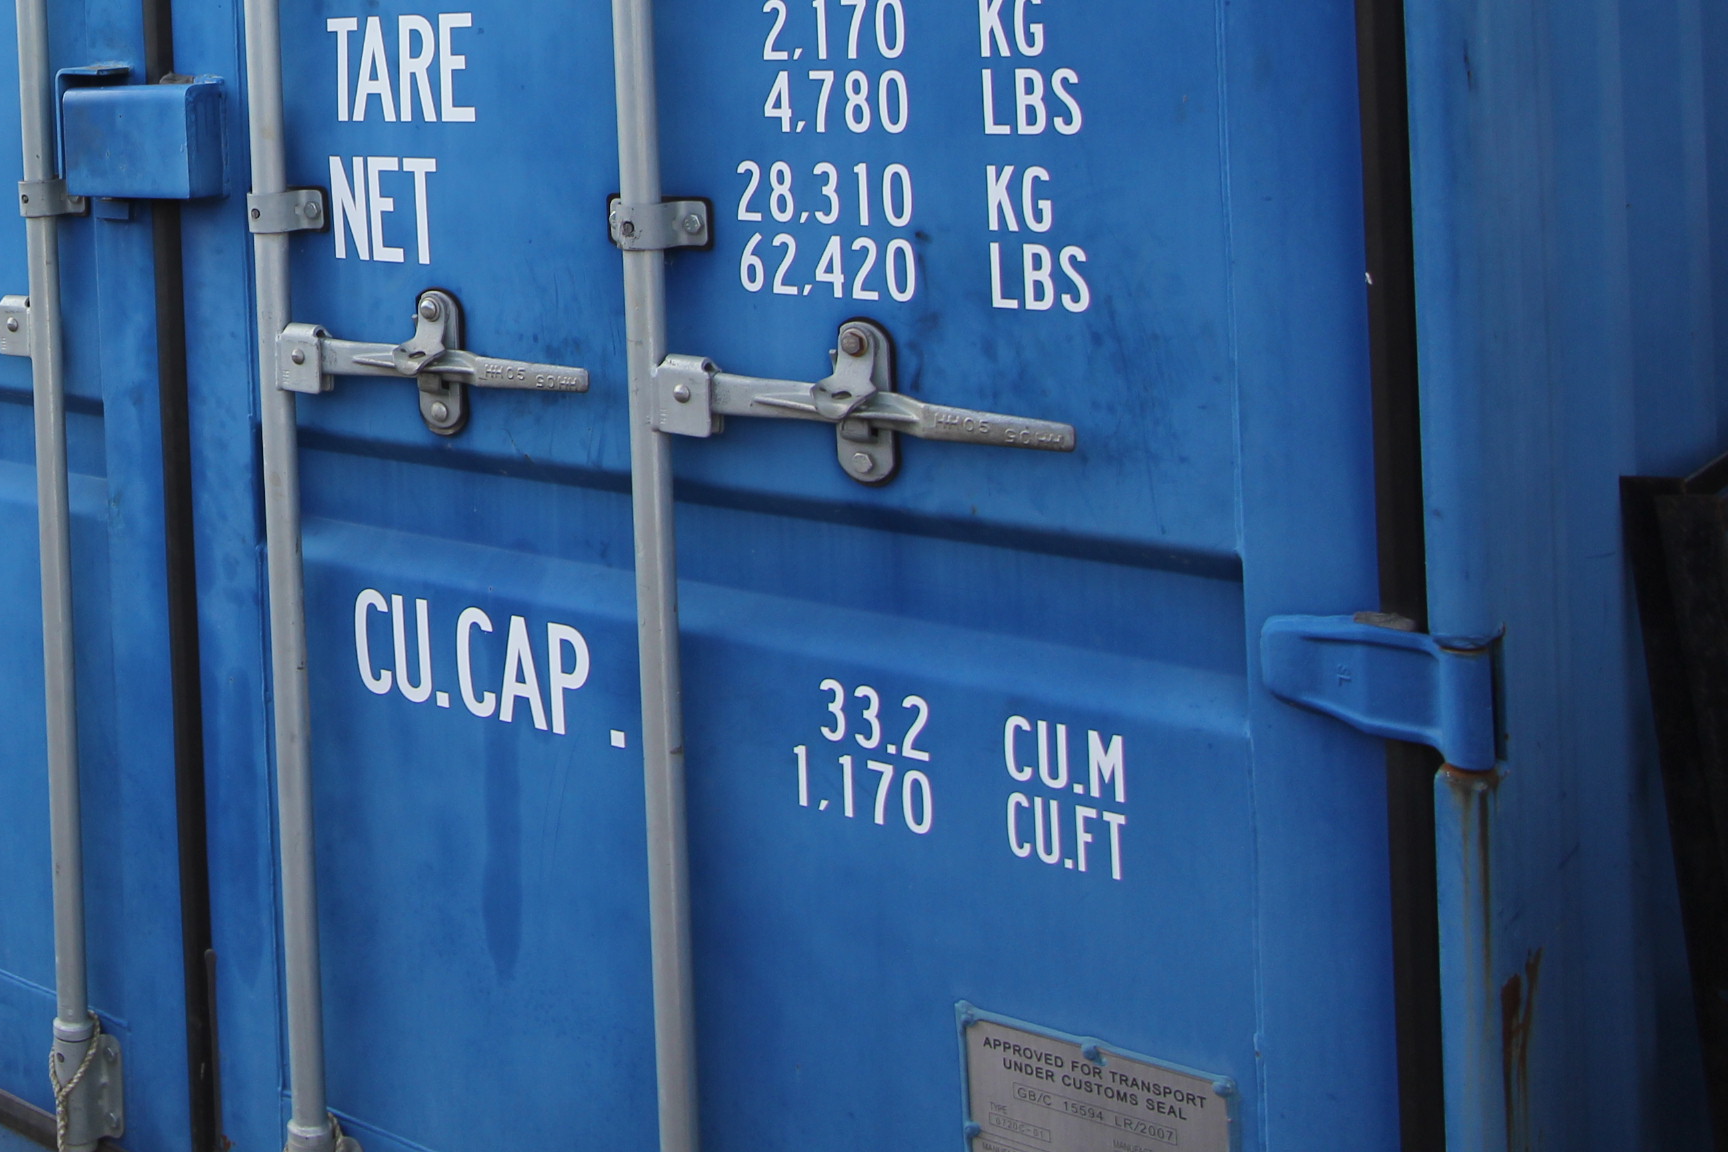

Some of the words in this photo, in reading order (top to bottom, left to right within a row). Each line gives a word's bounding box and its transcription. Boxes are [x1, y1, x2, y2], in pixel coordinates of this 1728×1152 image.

[327, 13, 475, 121] TARE
[765, 70, 908, 133] 4,780
[982, 68, 1082, 134] LBS
[330, 156, 436, 264] NET
[738, 161, 912, 226] 28,310
[987, 166, 1052, 232] KG
[741, 233, 915, 301] 62,420
[990, 243, 1090, 312] LBS
[820, 679, 929, 763] 33.2
[1005, 716, 1125, 804] CU.M
[794, 741, 932, 834] 1,170
[1008, 791, 1126, 880] CU.FT
[983, 1036, 1064, 1069] APPROVED
[1071, 1060, 1103, 1080] FOR
[1109, 1071, 1207, 1109] TRANSPORT
[989, 1101, 1008, 1115] TYPE
[1002, 1057, 1055, 1083] UNDER
[1061, 1075, 1138, 1106] CUSTOMS
[1146, 1098, 1188, 1121] SEAL
[1017, 1087, 1052, 1107] GB/C
[1063, 1101, 1104, 1121] 15594
[1114, 1116, 1174, 1142] LR/2007
